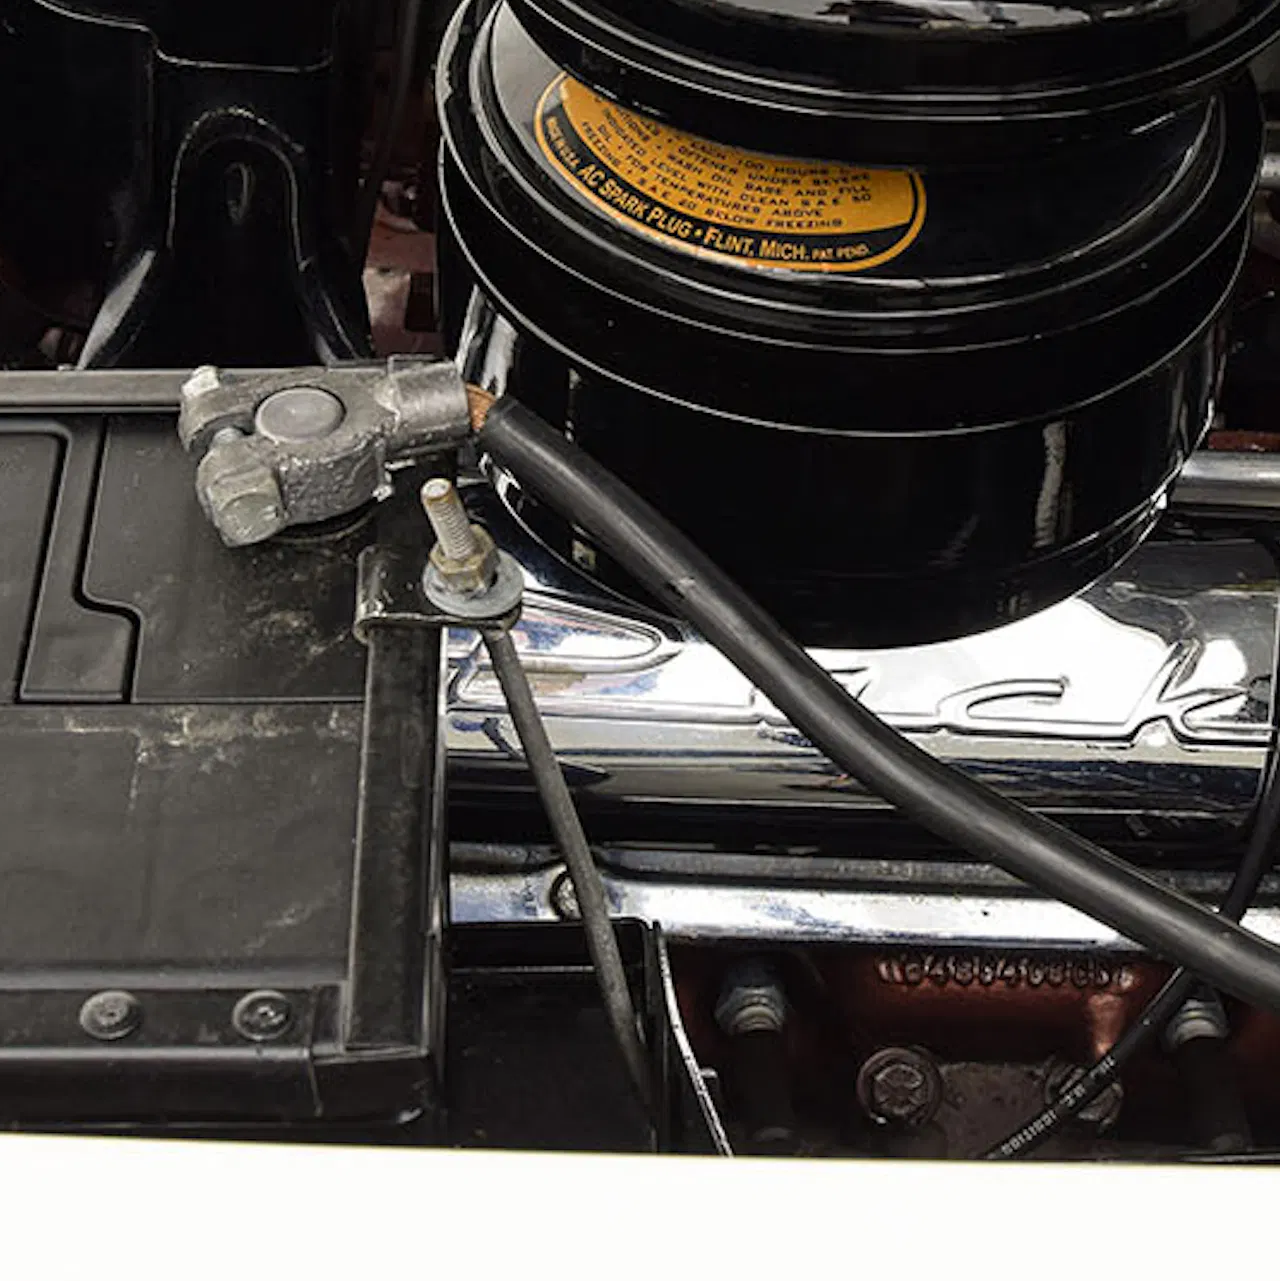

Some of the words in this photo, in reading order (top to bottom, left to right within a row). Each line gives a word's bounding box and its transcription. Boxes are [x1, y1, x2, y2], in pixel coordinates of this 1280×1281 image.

[581, 121, 621, 166] FREEZING
[705, 207, 755, 224] BELOW
[765, 219, 843, 228] FREEZING
[626, 154, 649, 173] FOR
[655, 173, 760, 213] TEMPERATURES
[771, 208, 824, 218] ABOVE
[651, 159, 689, 182] LEVEL
[697, 182, 730, 196] WITH
[740, 193, 789, 206] CLEAN
[667, 153, 702, 175] WASH
[745, 182, 782, 195] BASE
[795, 189, 827, 197] AND
[678, 145, 738, 175] OFTENER
[748, 173, 801, 186] UNDER
[812, 173, 871, 186] SEVERE
[774, 166, 830, 176] HOURS
[577, 163, 606, 187] AC
[598, 178, 649, 219] SPARK
[645, 206, 694, 239] PLUG
[759, 238, 809, 261] MICH.
